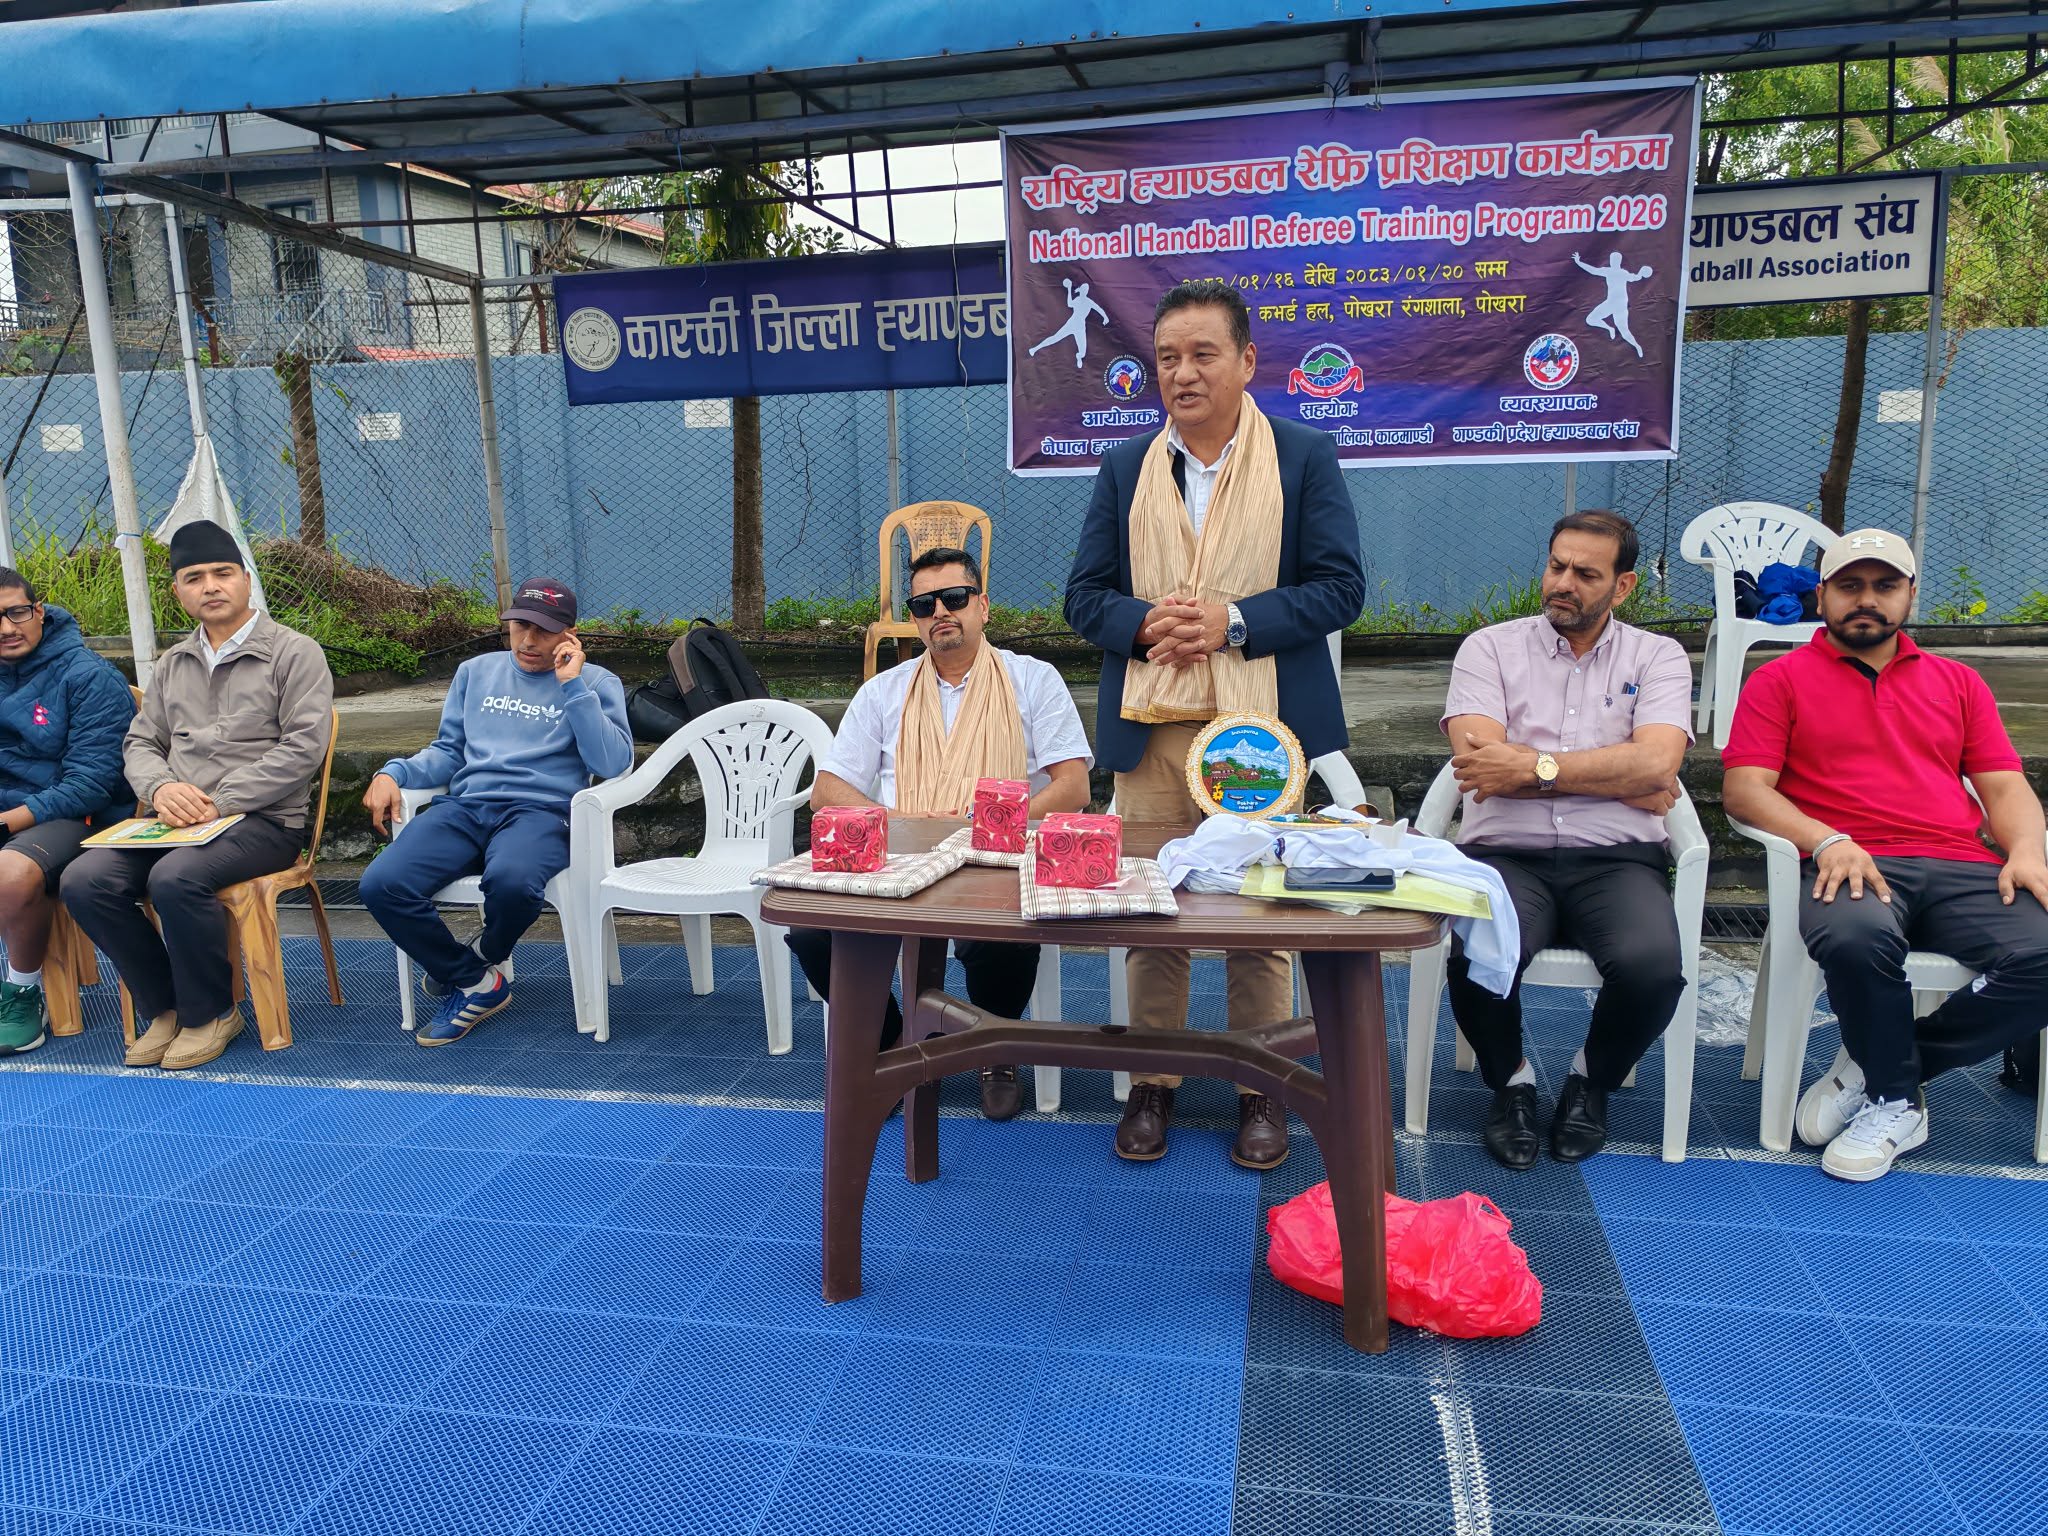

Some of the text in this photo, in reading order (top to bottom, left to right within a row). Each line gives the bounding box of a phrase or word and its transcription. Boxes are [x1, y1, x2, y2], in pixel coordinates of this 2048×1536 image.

[1022, 165, 1126, 213] राष्ट्रिय
[1295, 142, 1371, 191] रेफ्रि
[1376, 138, 1511, 188] प्रशिक्षण
[1516, 131, 1672, 175] कार्यक्रम
[1030, 194, 1666, 262] National Handball Referee Training Program 2026
[1691, 193, 1919, 248] याण्डबल संघ
[1303, 263, 1337, 287] देखि
[1346, 263, 1463, 284] २०८३/०१/२०
[1475, 261, 1509, 279] सम्म
[1690, 249, 1910, 282] dball Association
[1259, 290, 1527, 323] कभर्ड हल, पोखरा रंगशाला, पोखरा
[623, 296, 740, 360] कास्की
[751, 293, 862, 353] जिल्ला
[874, 292, 1007, 352] ह्याण्डब
[1041, 436, 1089, 456] नेपाल
[1453, 421, 1505, 442] गण्डकी
[1506, 420, 1541, 443] प्रदेश
[1613, 419, 1640, 439] संघ
[480, 707, 560, 725] ORIGINALS
[483, 695, 541, 716] adidas
